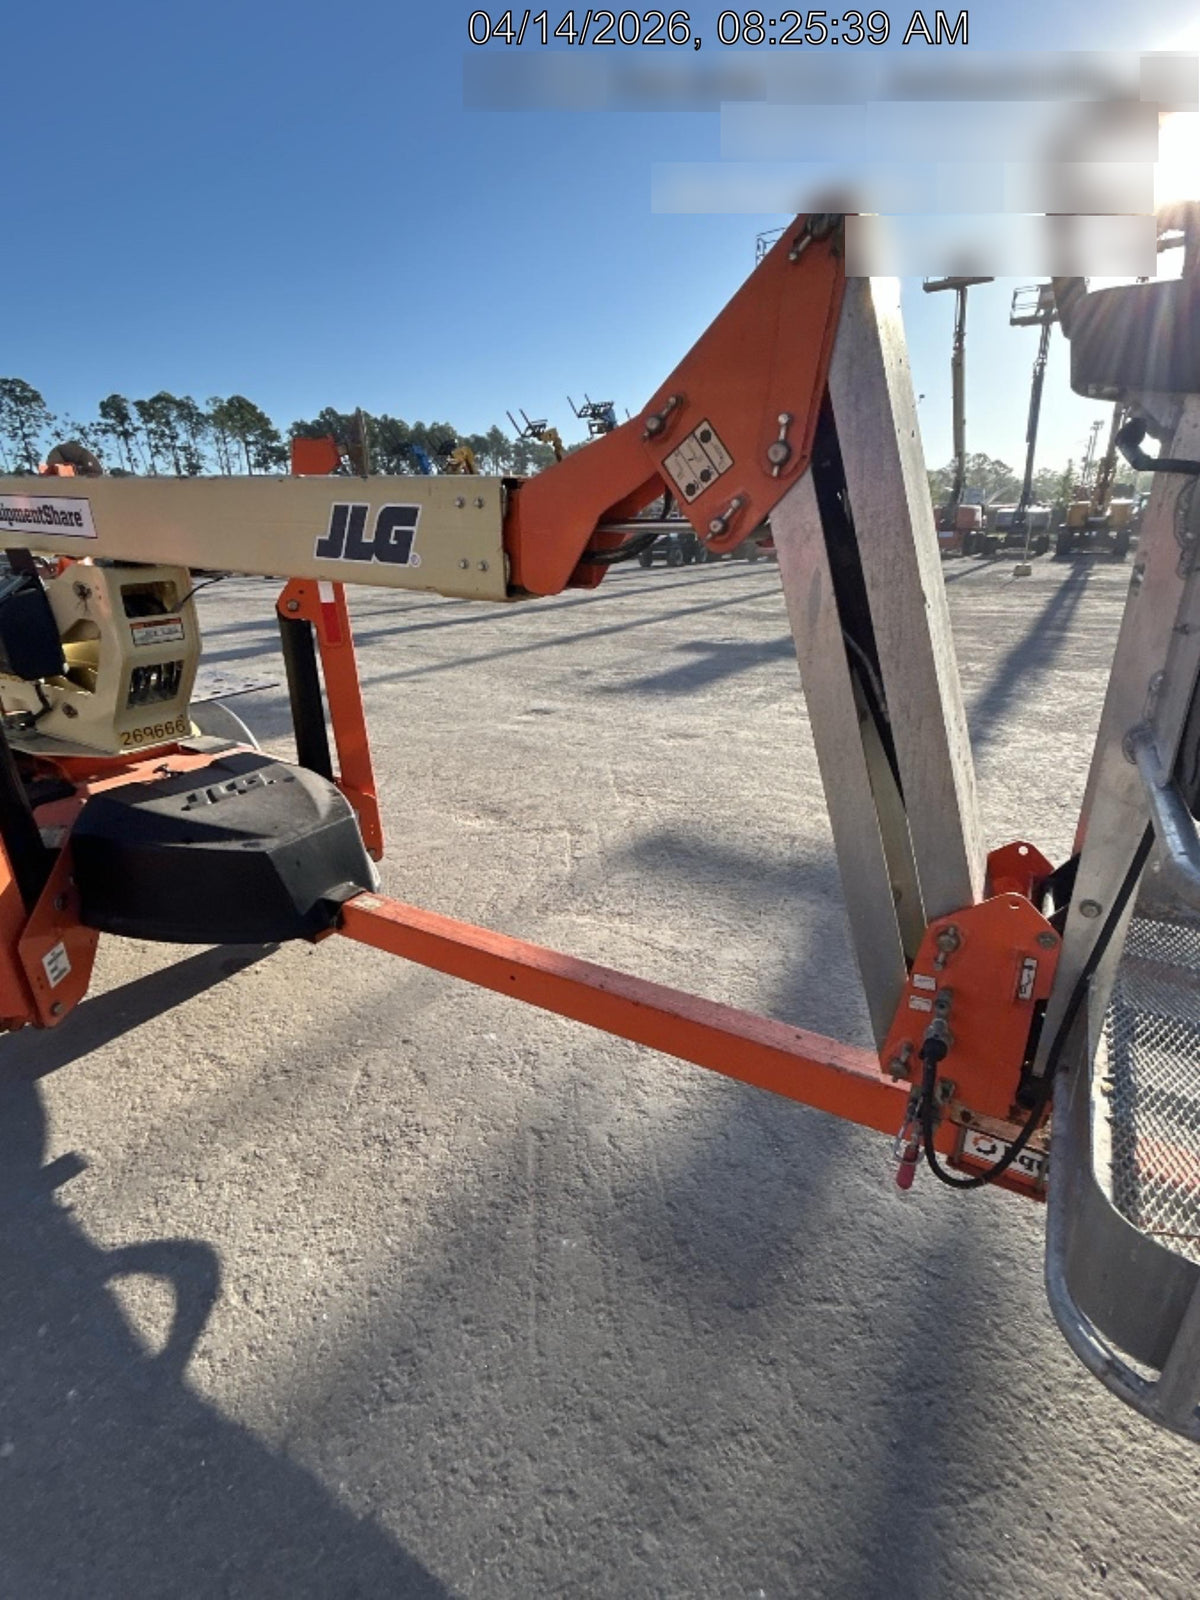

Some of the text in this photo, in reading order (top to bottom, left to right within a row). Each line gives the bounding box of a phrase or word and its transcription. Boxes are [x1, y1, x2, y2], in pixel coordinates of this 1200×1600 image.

[0, 503, 84, 527] ipmentShare
[315, 503, 420, 566] JLG
[121, 717, 186, 746] 269666
